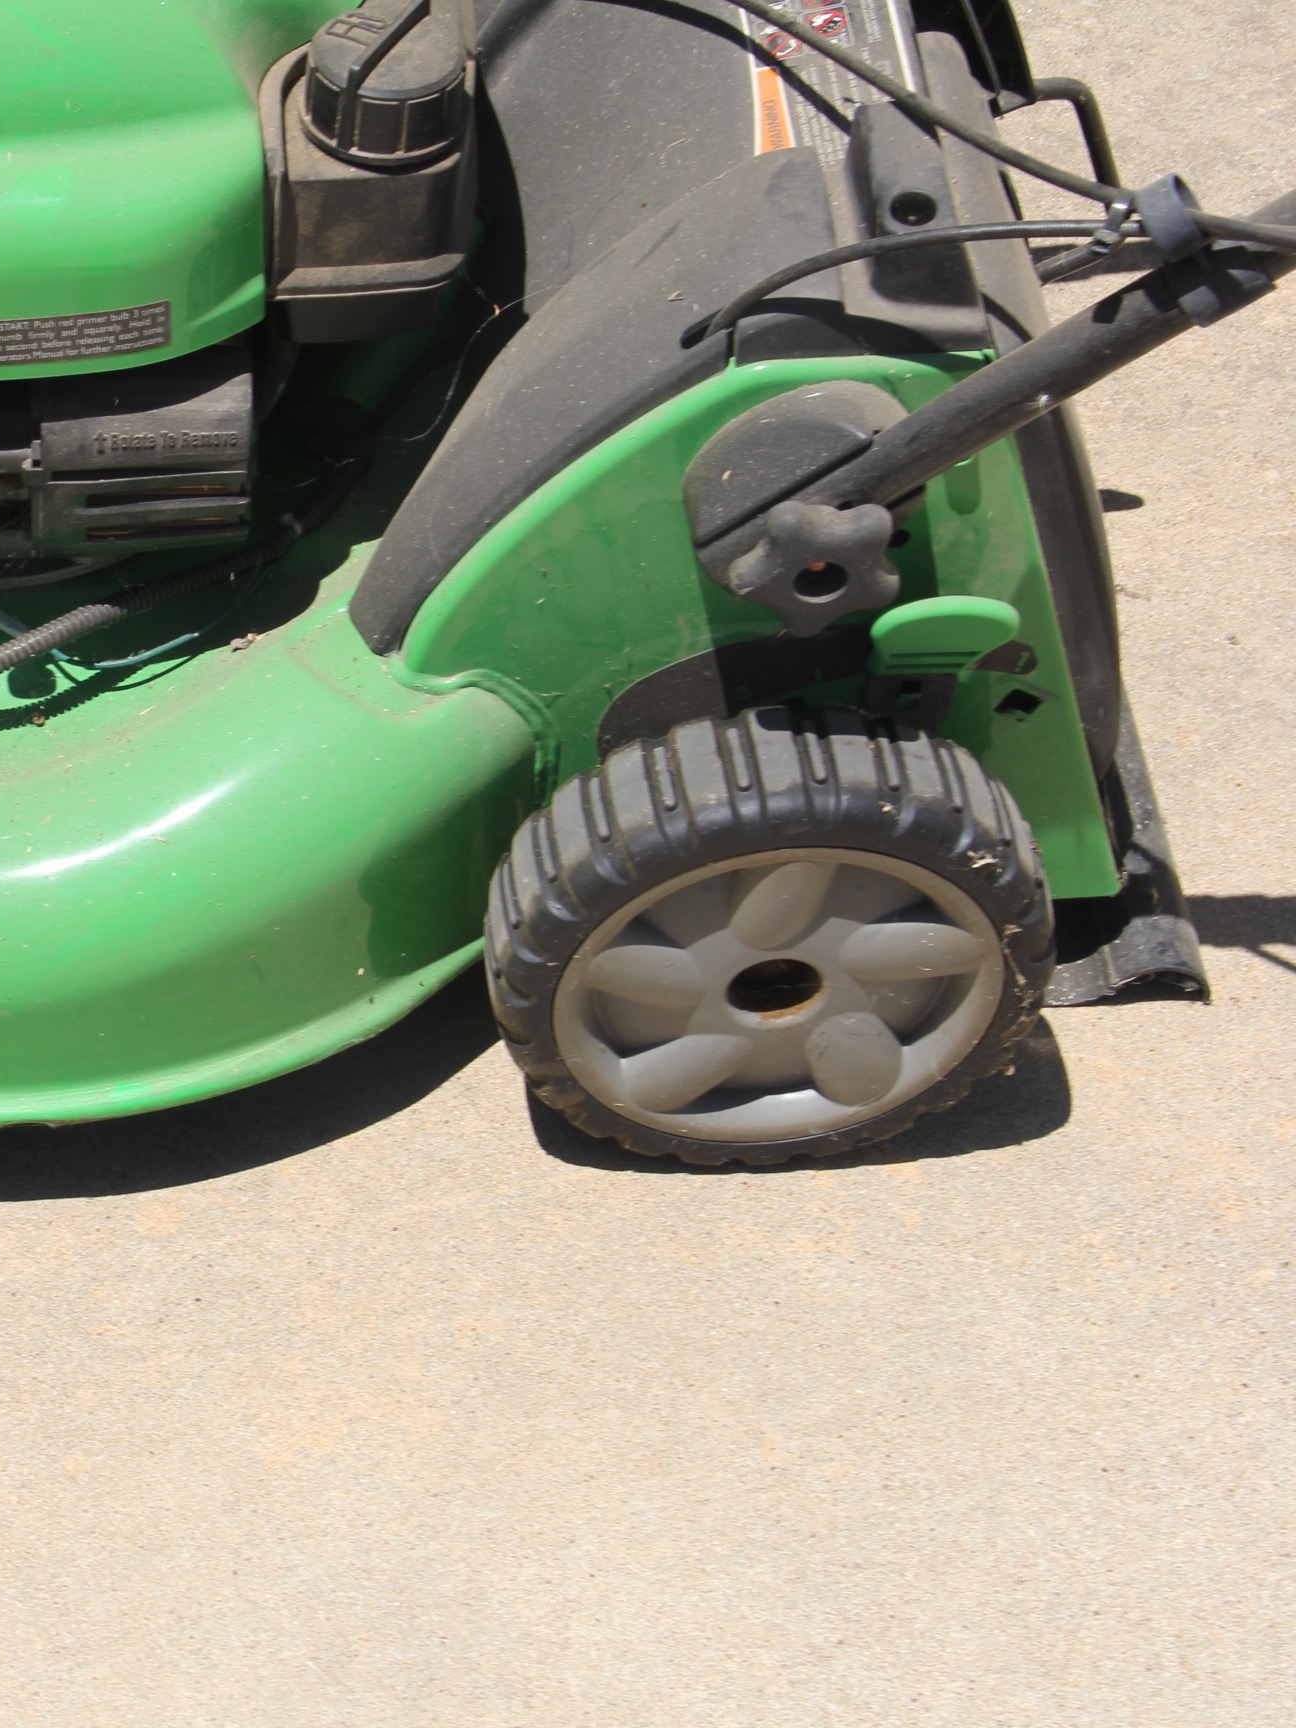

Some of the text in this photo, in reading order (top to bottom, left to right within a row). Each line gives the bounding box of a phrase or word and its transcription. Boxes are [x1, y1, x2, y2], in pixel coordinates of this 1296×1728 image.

[762, 99, 785, 150] WARNING
[28, 331, 55, 341] firmly
[60, 329, 79, 337] and
[128, 318, 152, 328] Hold
[33, 320, 56, 330] Push
[58, 319, 75, 328] red
[77, 316, 108, 327] primer
[109, 312, 131, 321] bulb
[132, 309, 140, 318] 3
[5, 343, 39, 353] second
[41, 339, 73, 349] before
[75, 336, 116, 346] releasing
[118, 332, 141, 341] each
[32, 350, 64, 360] Manual
[65, 349, 80, 358] for
[81, 346, 113, 356] further
[109, 429, 239, 451] Rotate To Remove
